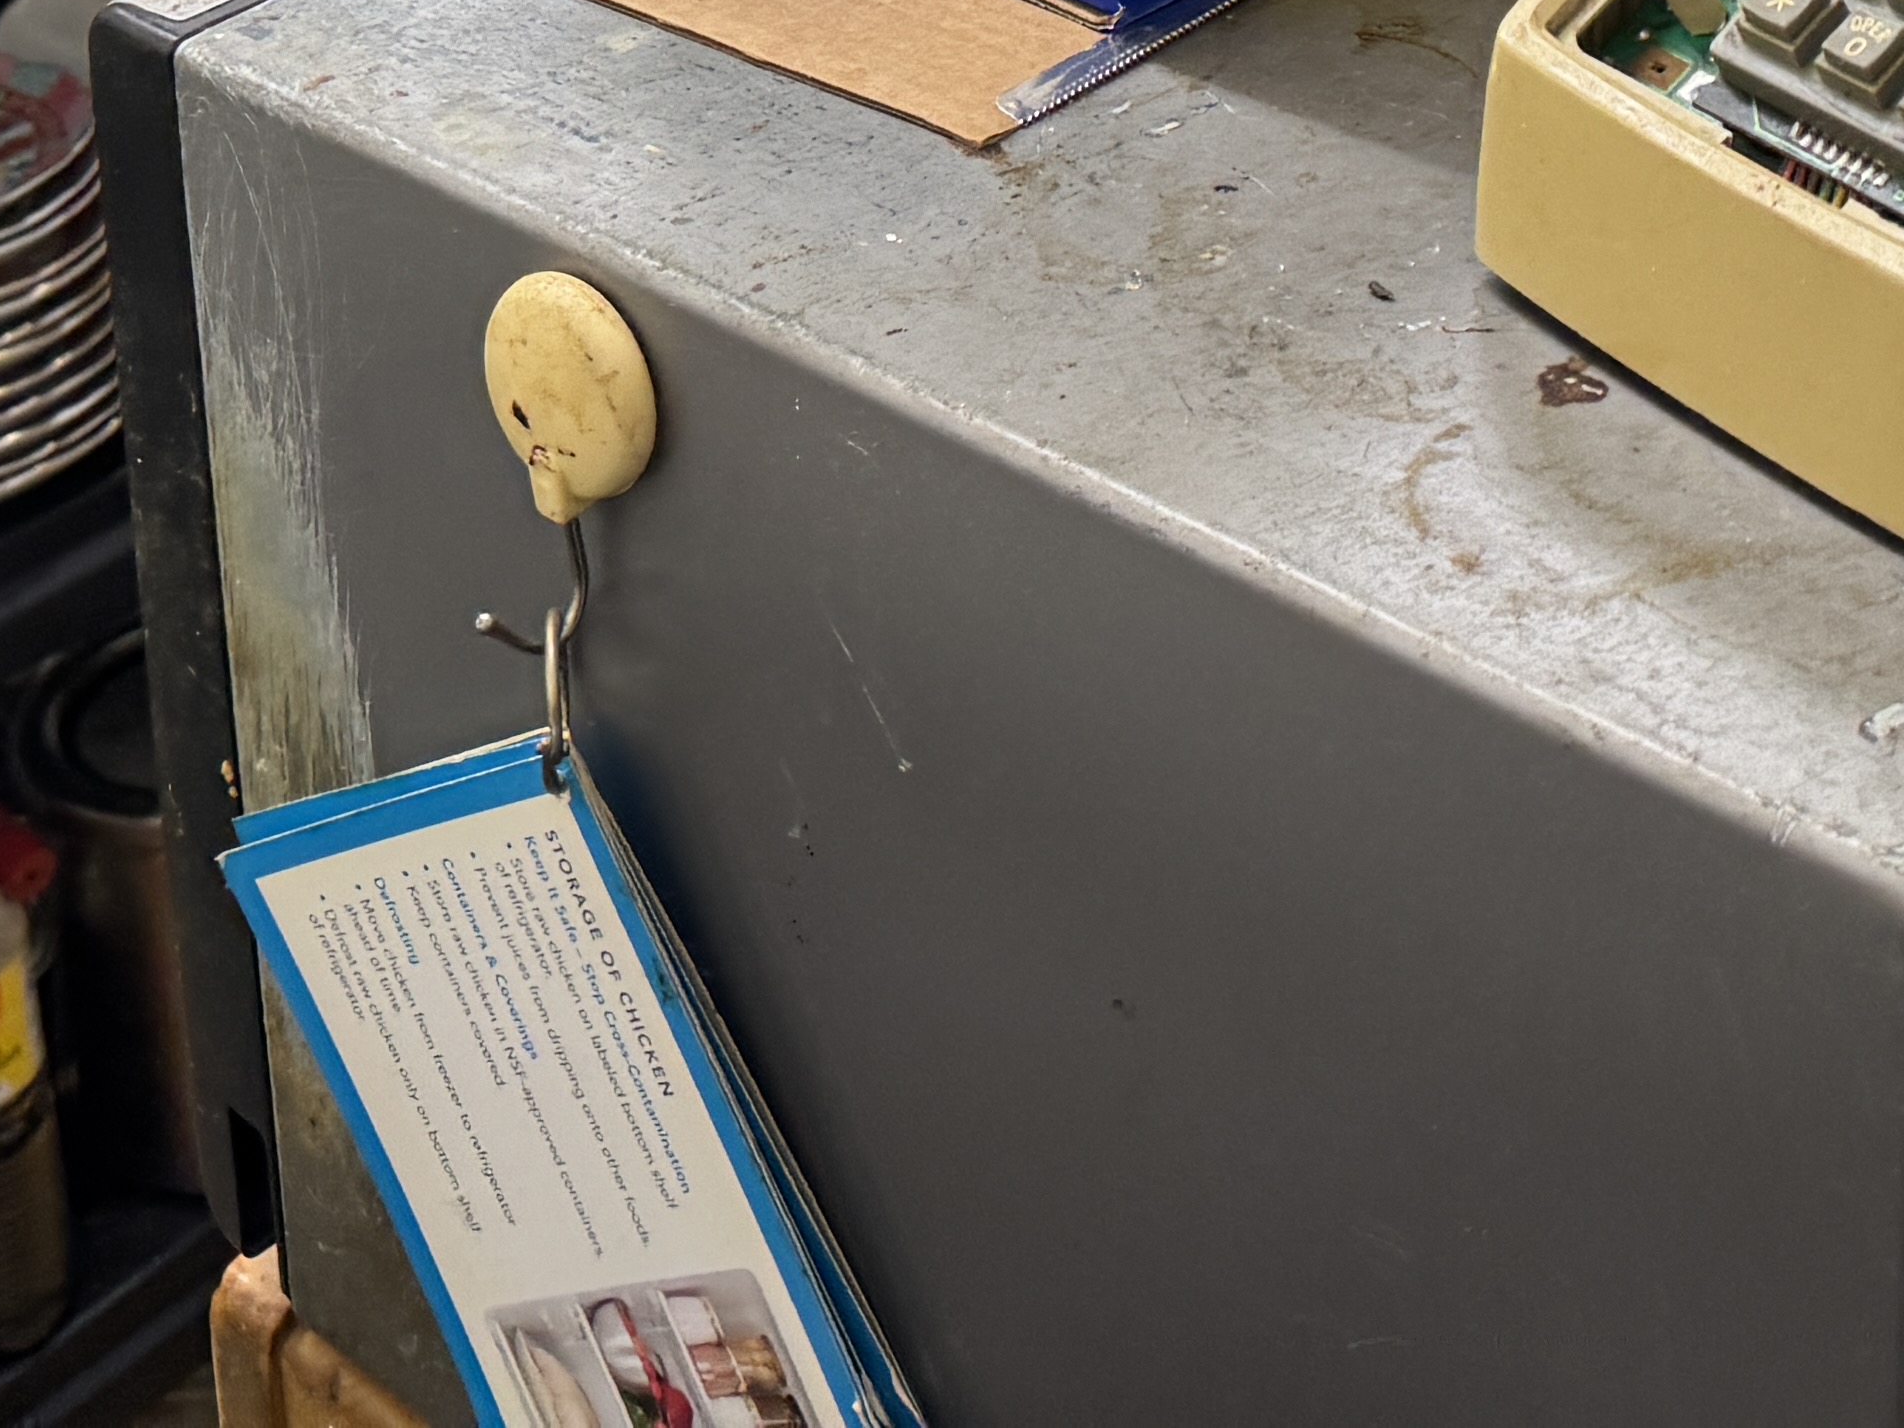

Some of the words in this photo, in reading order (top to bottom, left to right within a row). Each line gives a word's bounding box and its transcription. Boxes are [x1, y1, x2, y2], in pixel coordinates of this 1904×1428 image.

[1842, 36, 1868, 61] 0
[308, 913, 326, 929] of
[343, 903, 377, 952] ahead
[369, 956, 387, 972] of
[373, 876, 420, 965] Defrosting
[406, 885, 432, 929] Keep
[428, 932, 472, 1017] containers
[442, 857, 488, 950] Containers
[484, 955, 498, 969] &
[495, 973, 538, 1060] Coverings
[495, 861, 512, 878] of
[544, 829, 604, 941] STORAGE
[600, 950, 622, 981] OF
[619, 991, 675, 1097] CHICKEN
[323, 908, 358, 967] Defrost
[352, 970, 372, 999] raw
[368, 1003, 401, 1064] chicken
[398, 1067, 420, 1101] only
[416, 1105, 431, 1126] on
[427, 1129, 460, 1191] bottom
[456, 1195, 482, 1232] shelf
[359, 898, 386, 944] Move
[383, 948, 417, 1009] chicken
[413, 1012, 435, 1051] from
[432, 1054, 463, 1108] freezer
[460, 1113, 472, 1132] to
[426, 879, 452, 923] Store
[449, 927, 468, 956] raw
[464, 960, 498, 1023] chicken
[493, 1027, 507, 1043] in
[503, 1046, 567, 1167] NSF-approved
[473, 867, 510, 930] Prevent
[500, 934, 531, 981] juices
[528, 985, 550, 1024] from
[547, 1028, 586, 1100] dripping
[581, 1103, 604, 1143] onto
[601, 1147, 628, 1192] other
[509, 857, 536, 902] Store
[531, 906, 551, 937] raw
[548, 940, 582, 1004] chicken
[578, 1008, 594, 1031] on
[590, 1035, 627, 1098] labeled
[620, 1102, 654, 1166] bottom
[650, 1169, 680, 1209] shelf
[523, 835, 550, 882] Keep
[547, 887, 560, 900] It
[554, 904, 578, 944] Safe
[581, 963, 606, 1006] Stop
[603, 1010, 690, 1194] Cross-Contamination
